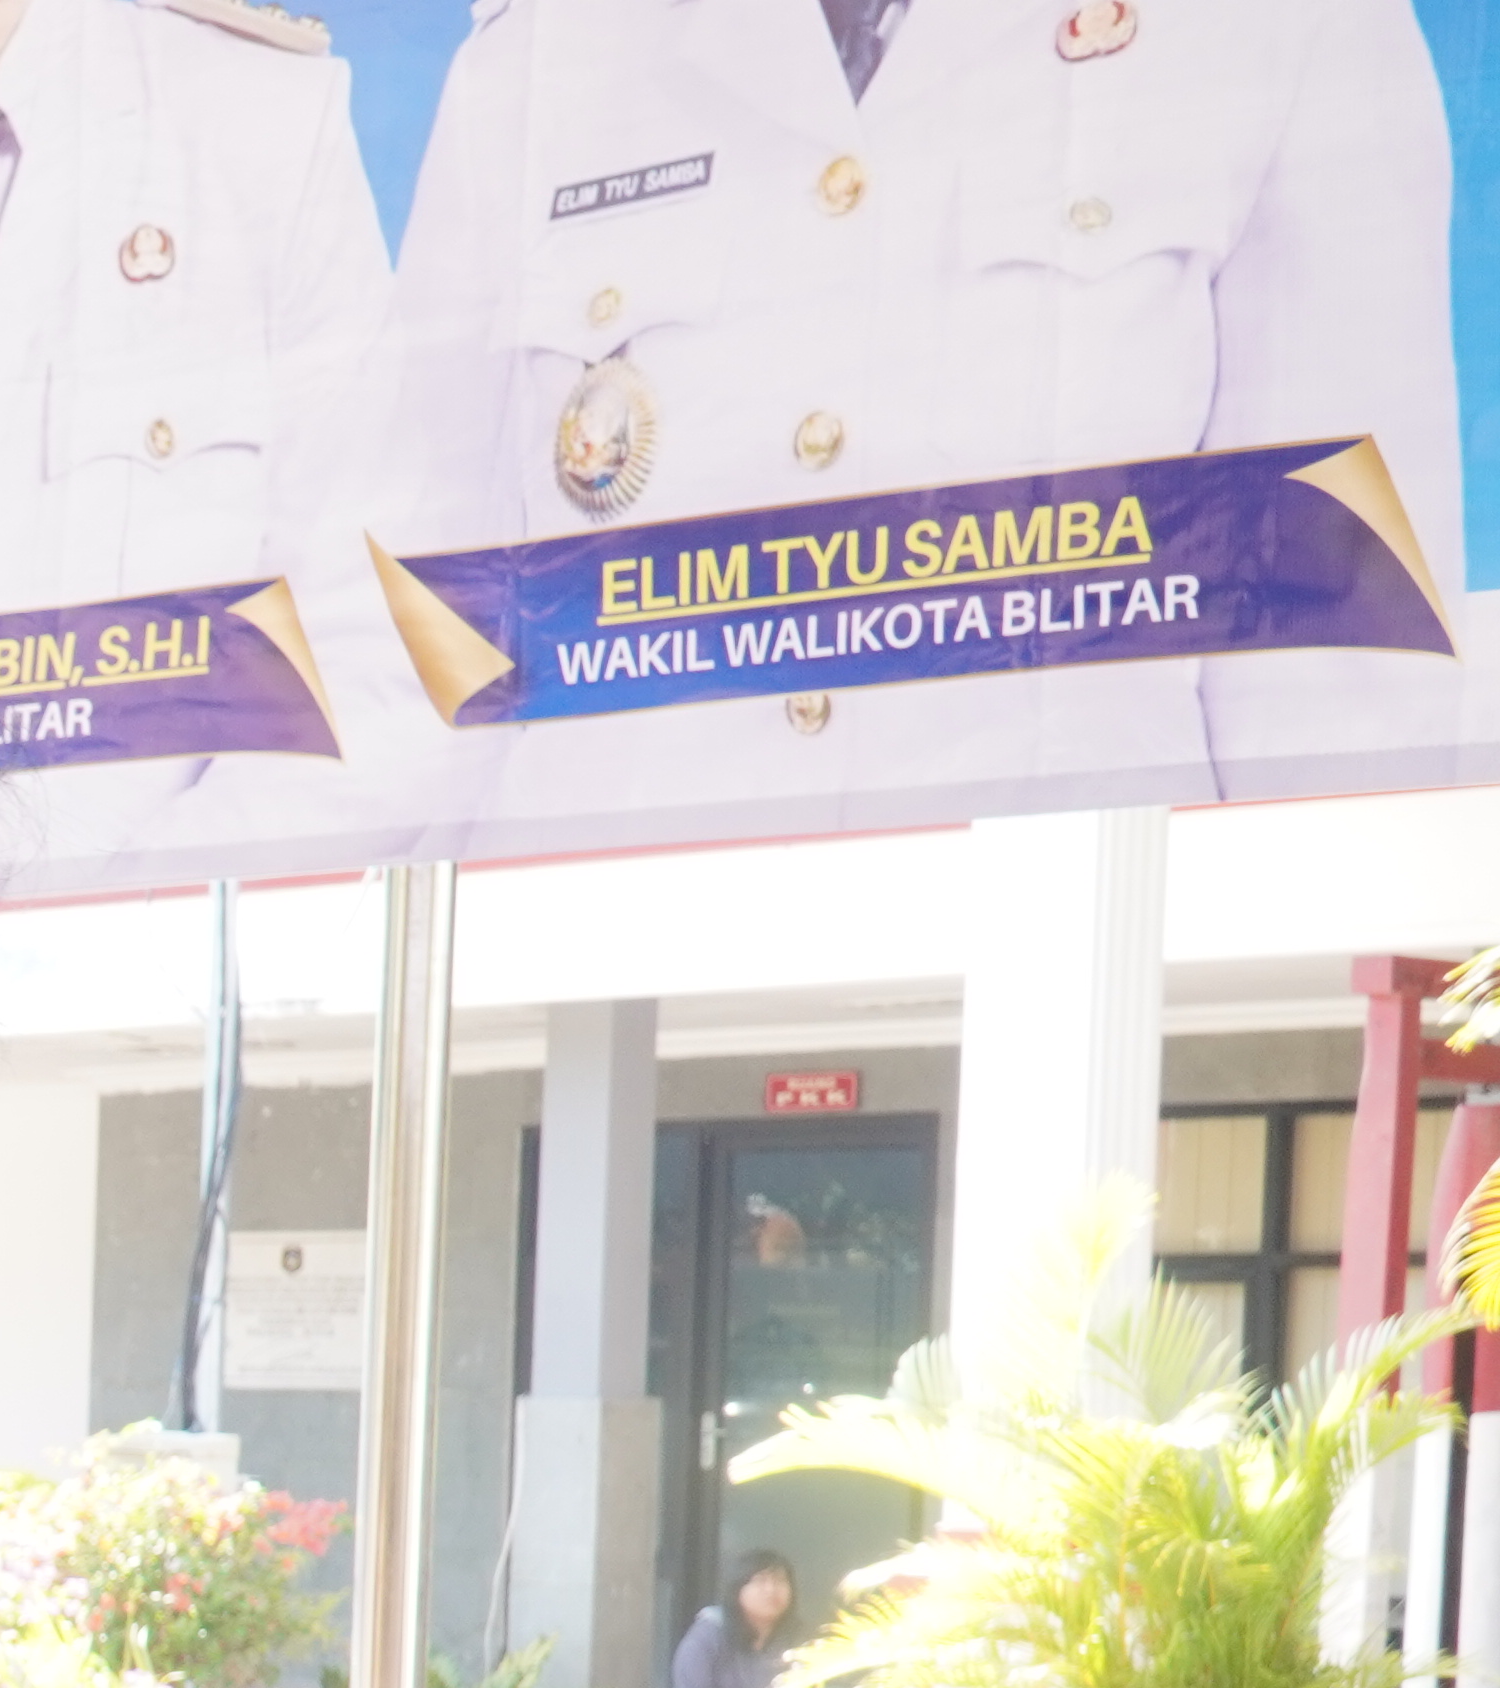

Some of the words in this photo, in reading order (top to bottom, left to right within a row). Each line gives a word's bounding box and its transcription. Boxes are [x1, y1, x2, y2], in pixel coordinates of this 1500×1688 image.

[556, 183, 599, 212] ELIM
[604, 174, 640, 201] TYU
[644, 159, 707, 192] SAMBA
[601, 543, 750, 615] ELIM
[762, 525, 890, 596] TYU
[901, 495, 1153, 579] SAMBA
[557, 628, 715, 686] WAKIL
[722, 596, 991, 668] WALIKOTA
[1000, 573, 1200, 638] BLITAR
